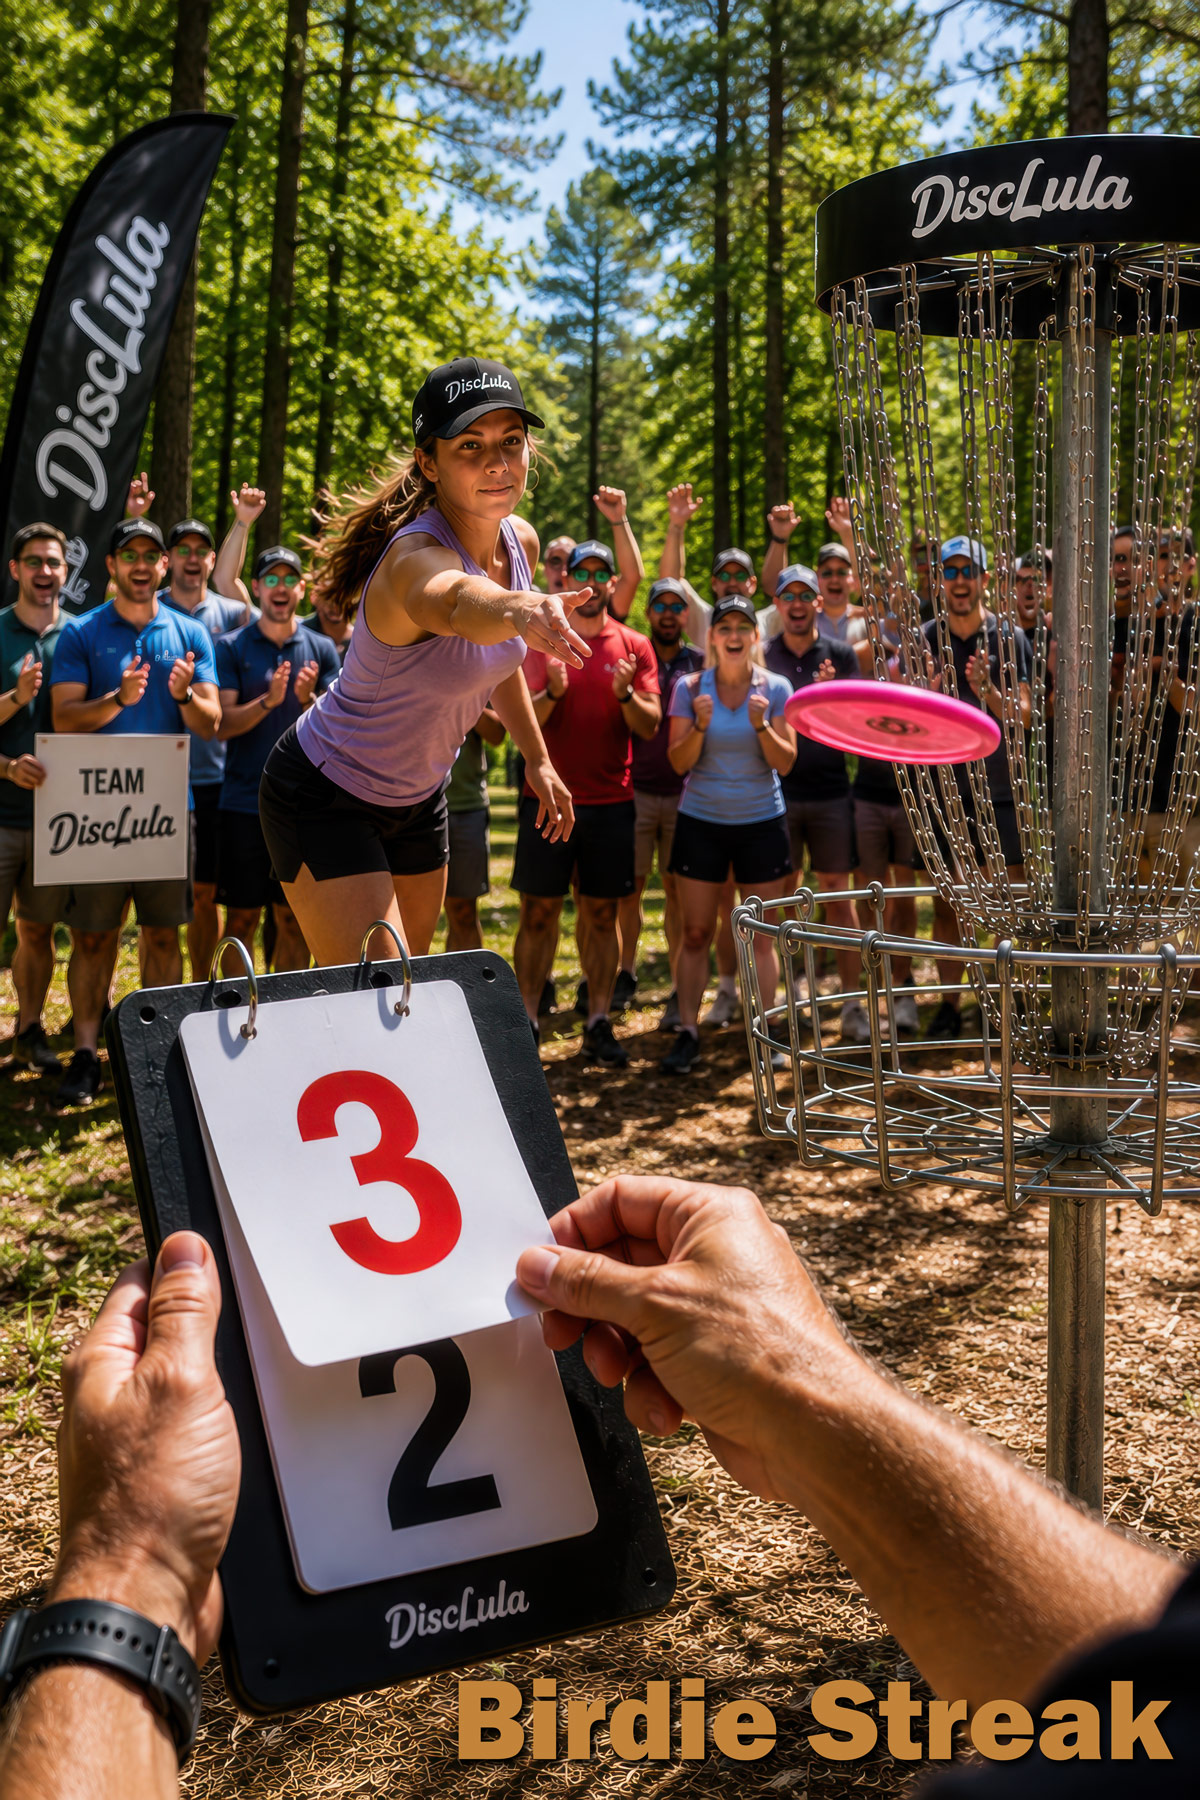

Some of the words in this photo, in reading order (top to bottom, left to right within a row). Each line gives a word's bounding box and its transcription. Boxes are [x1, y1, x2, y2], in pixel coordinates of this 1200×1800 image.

[911, 154, 1133, 238] DiscLula
[35, 215, 170, 512] DiscLula
[445, 372, 512, 404] DiscLula
[79, 767, 144, 795] TEAM
[49, 804, 176, 856] DiscLula
[297, 1070, 462, 1275] 3
[358, 1337, 502, 1531] 2
[385, 1579, 530, 1650] DiscLula
